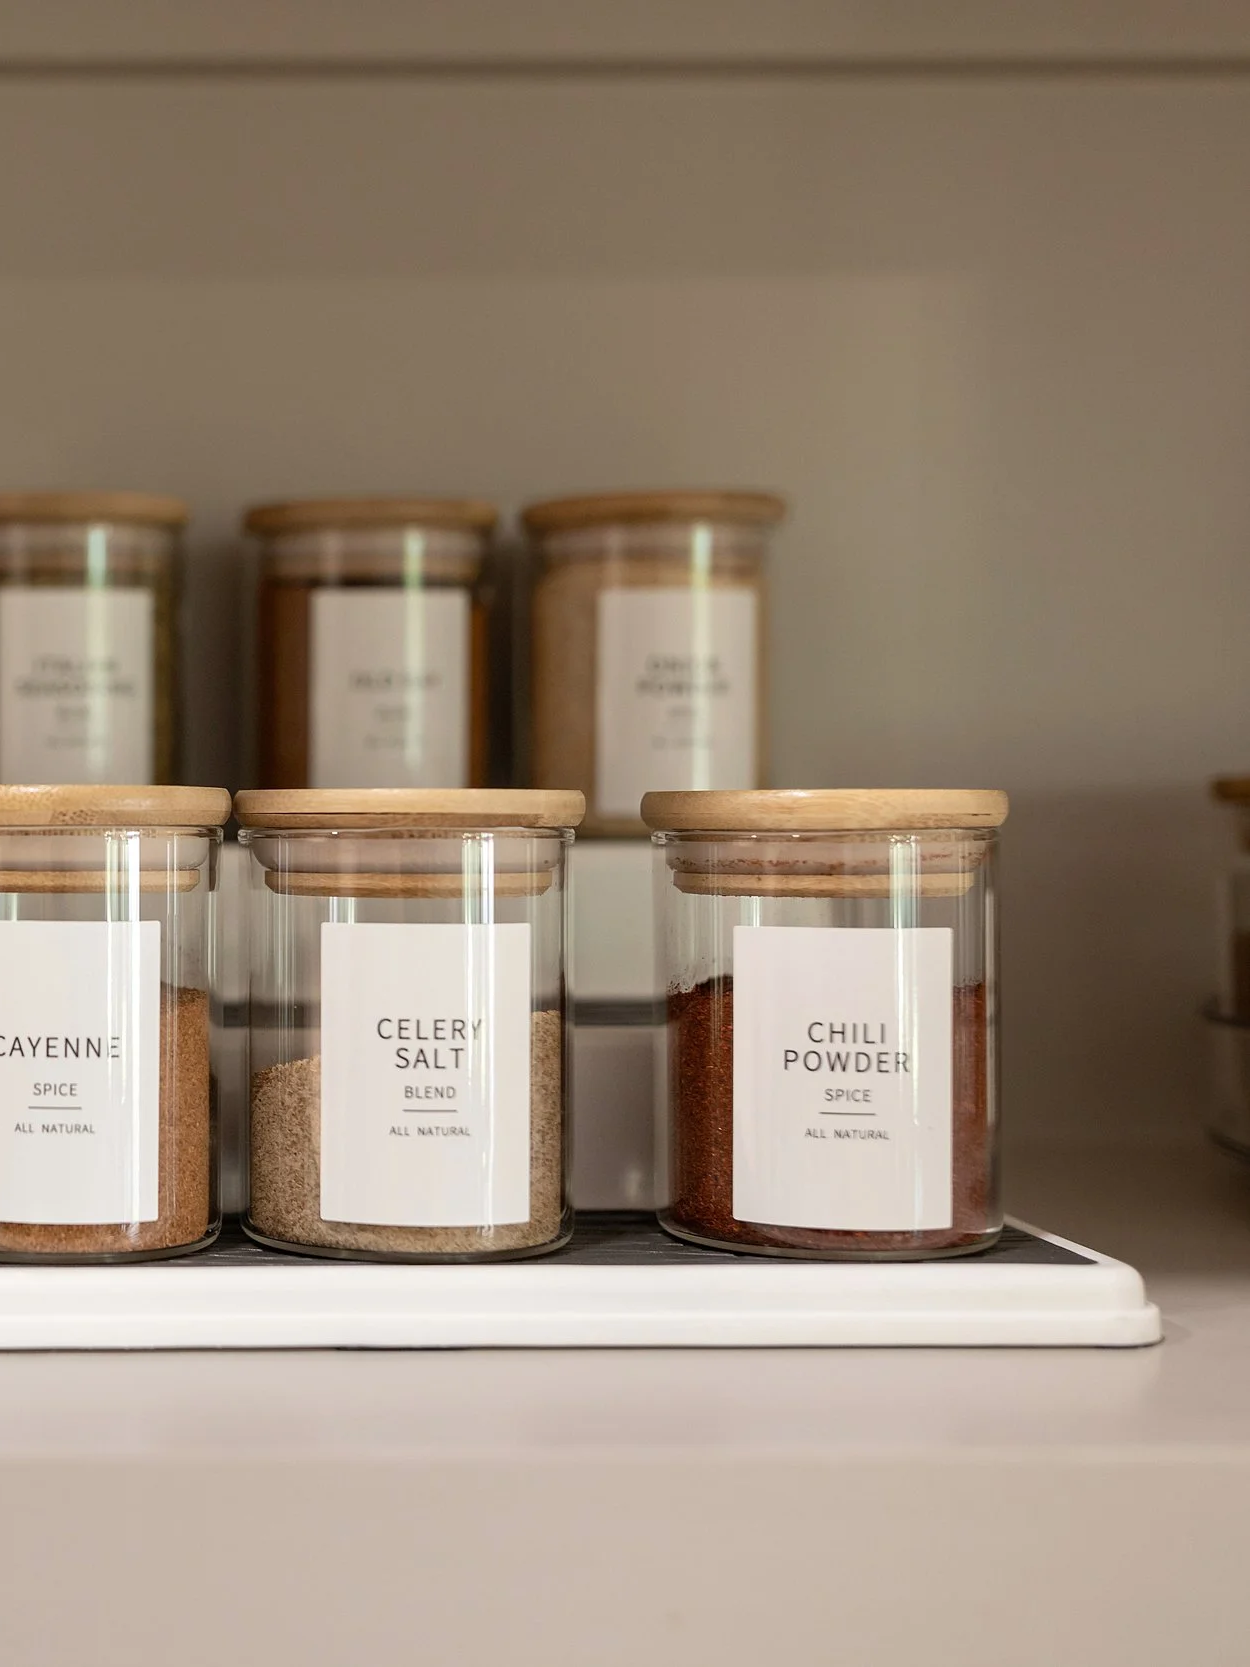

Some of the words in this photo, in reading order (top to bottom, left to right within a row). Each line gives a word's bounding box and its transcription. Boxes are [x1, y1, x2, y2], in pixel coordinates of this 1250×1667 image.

[377, 1018, 482, 1040] CELERY
[807, 1021, 886, 1044] CHILI
[395, 1047, 465, 1069] SALT
[783, 1049, 910, 1073] POWDER
[32, 1082, 78, 1097] SPICE
[403, 1085, 456, 1099] BLEND
[824, 1088, 872, 1103] SPICE
[14, 1123, 34, 1133] ALL
[41, 1123, 95, 1134] NATURAL
[388, 1125, 410, 1136] ALL
[416, 1126, 471, 1137] NATURAL
[804, 1127, 826, 1139] ALL
[833, 1128, 890, 1140] NATURAL
